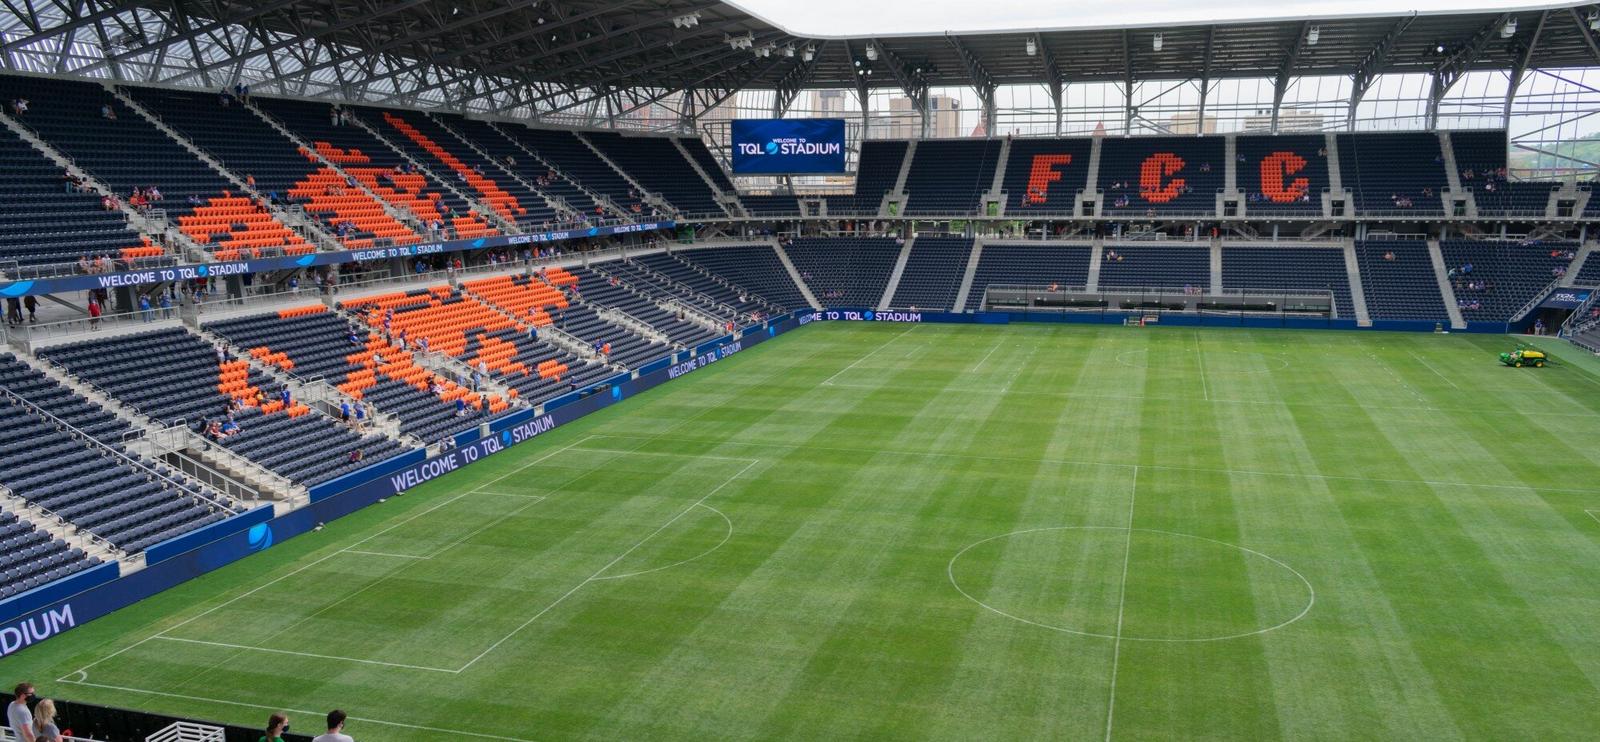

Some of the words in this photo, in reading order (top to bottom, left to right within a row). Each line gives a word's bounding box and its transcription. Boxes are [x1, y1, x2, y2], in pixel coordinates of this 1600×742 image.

[738, 143, 765, 155] TQL
[781, 143, 840, 154] STADIUM
[508, 235, 531, 244] WELCOME
[551, 232, 569, 240] STADIUM
[352, 249, 386, 261] WELCOME
[388, 248, 397, 257] TO
[399, 246, 411, 256] TQL
[417, 244, 443, 254] STADIUM
[99, 271, 156, 287] WELCOME
[160, 270, 175, 281] TO
[178, 267, 198, 279] TQL
[208, 262, 249, 276] STADIUM
[826, 311, 839, 320] TO
[844, 311, 863, 320] TQL
[875, 312, 921, 322] STADIUM
[667, 359, 696, 379] WELCOME
[698, 355, 706, 367] TO
[706, 351, 718, 363] TQL
[721, 341, 742, 358] STADIUM
[391, 454, 459, 492] WELCOME
[461, 447, 478, 463] TO
[481, 436, 504, 455] TQL
[512, 415, 554, 443] STADIUM
[0, 604, 75, 656] DIUM
